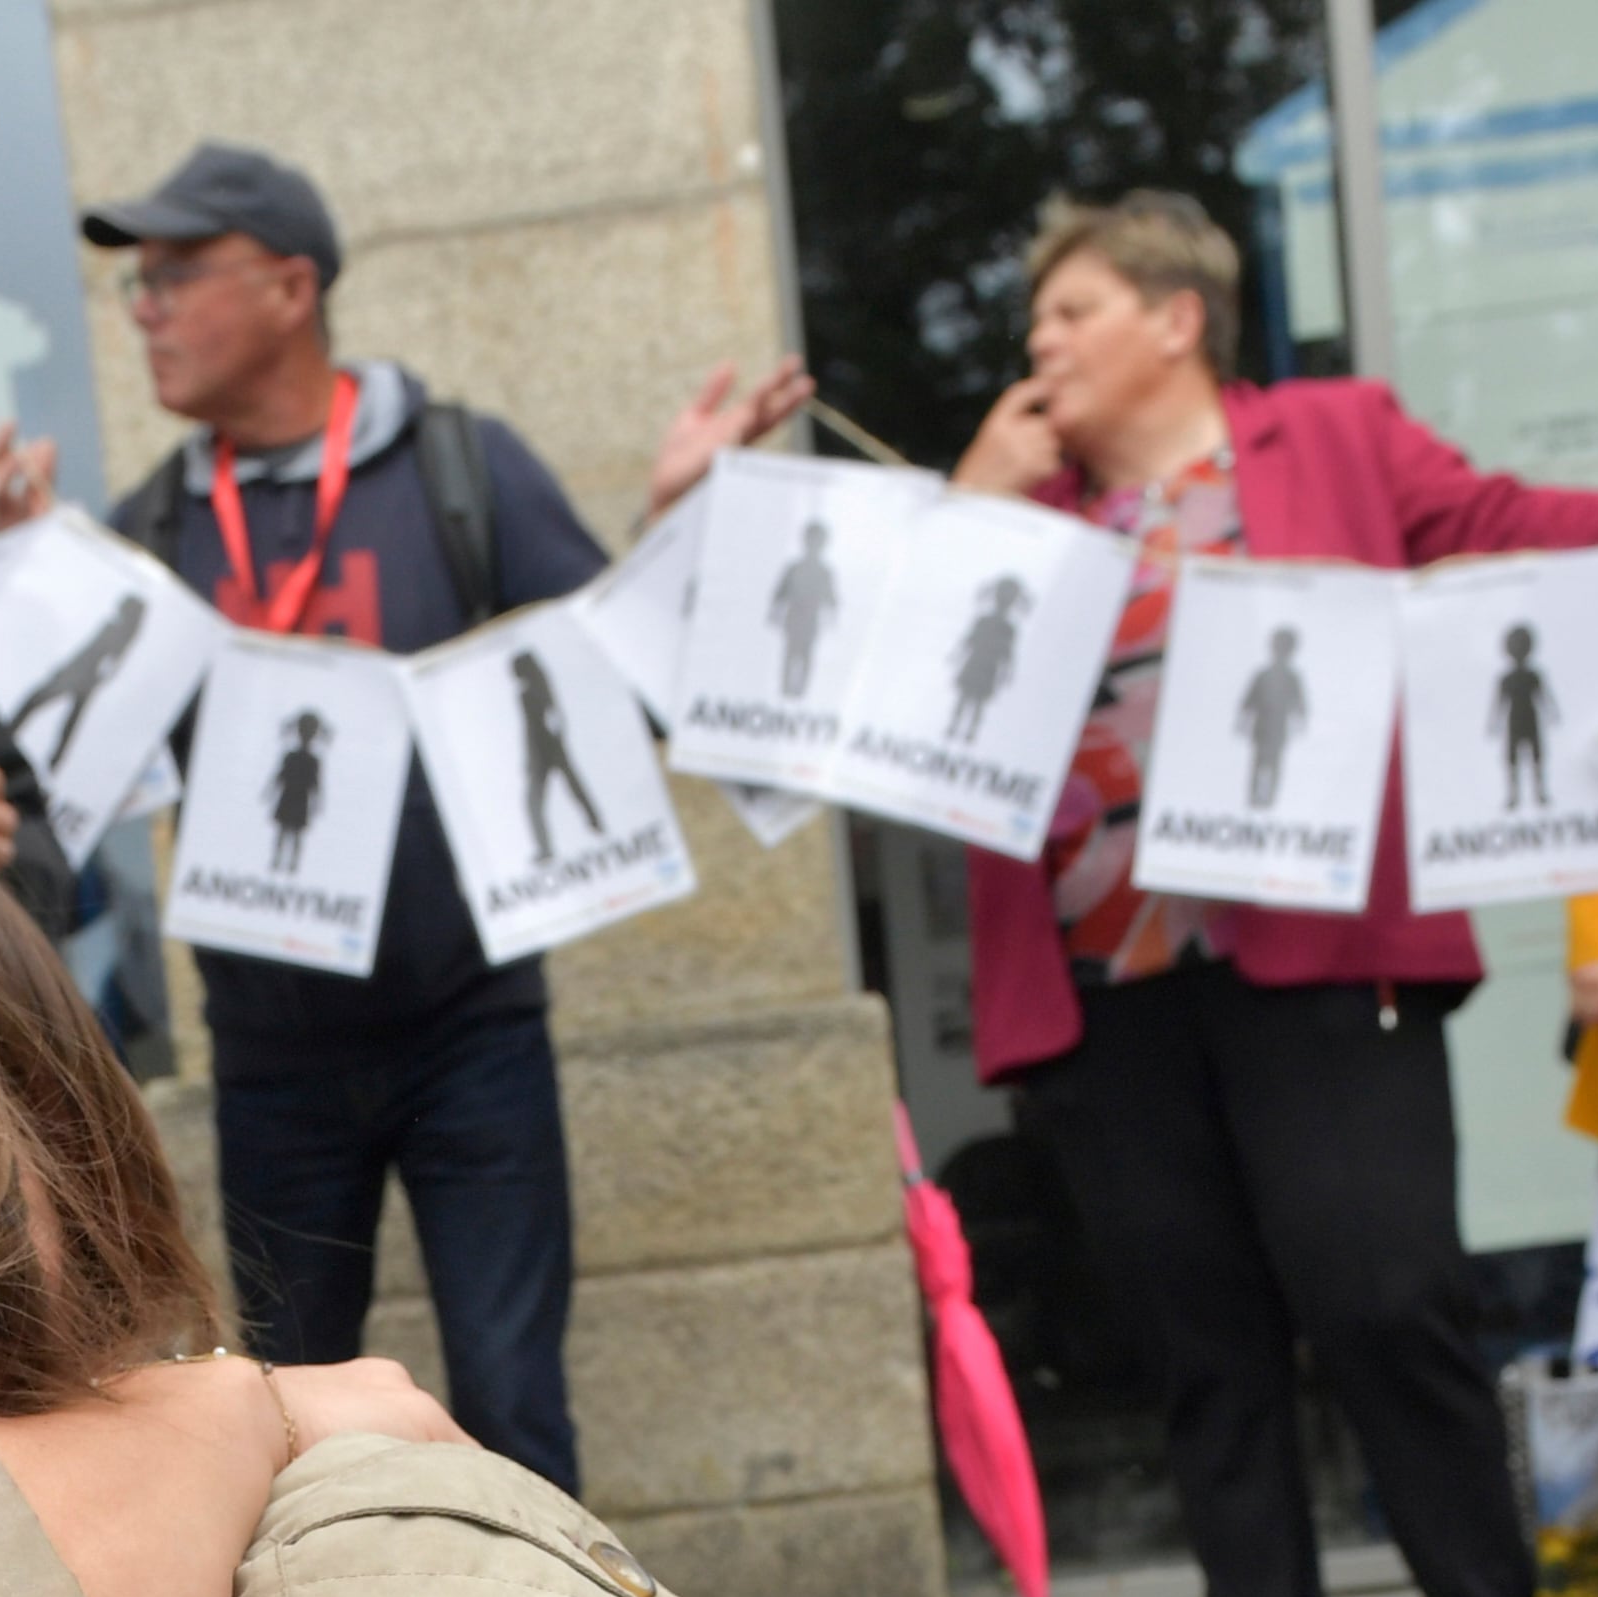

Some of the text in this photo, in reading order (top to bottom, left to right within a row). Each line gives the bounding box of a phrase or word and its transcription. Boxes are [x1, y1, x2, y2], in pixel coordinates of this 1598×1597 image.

[851, 723, 1047, 811] ANONYME
[483, 820, 675, 917] ANONYME
[1152, 804, 1360, 861] ANONYME
[179, 866, 367, 930] ANONYME
